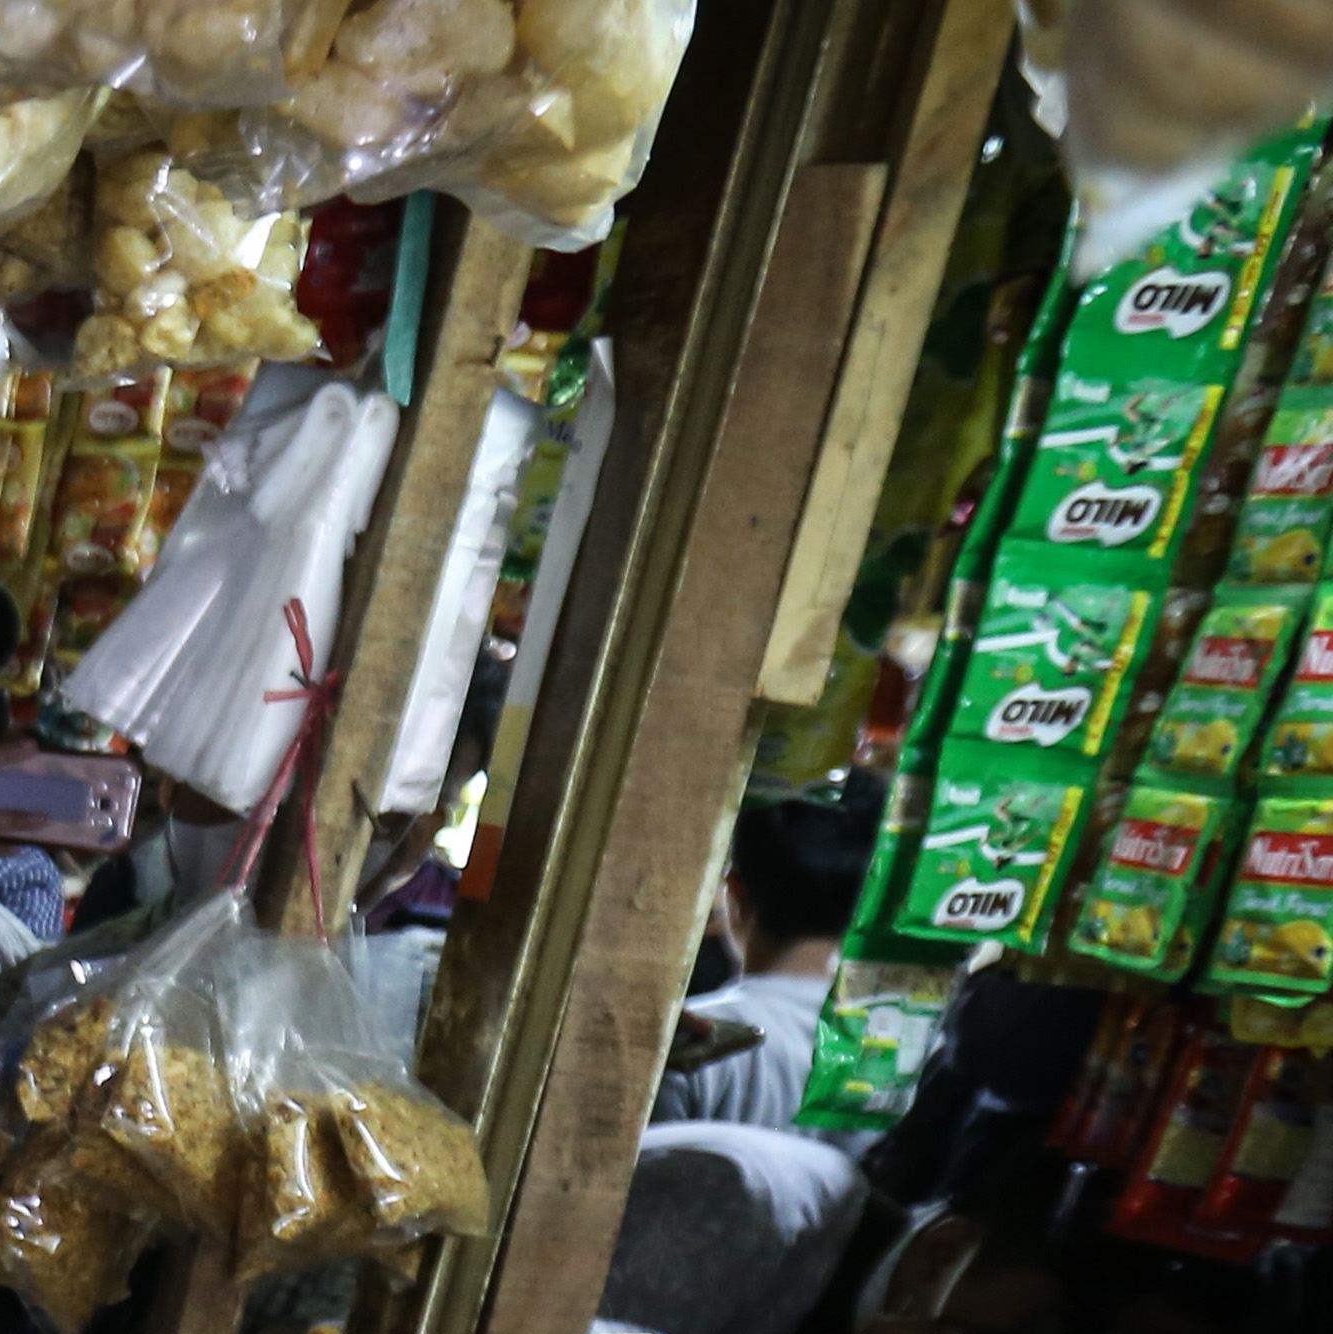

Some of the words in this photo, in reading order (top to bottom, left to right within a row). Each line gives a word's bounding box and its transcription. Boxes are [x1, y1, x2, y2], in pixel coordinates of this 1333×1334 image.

[1134, 280, 1223, 311] MILO
[1063, 496, 1153, 526] MILO
[1002, 698, 1089, 726] MILO
[946, 891, 1019, 917] MILO
